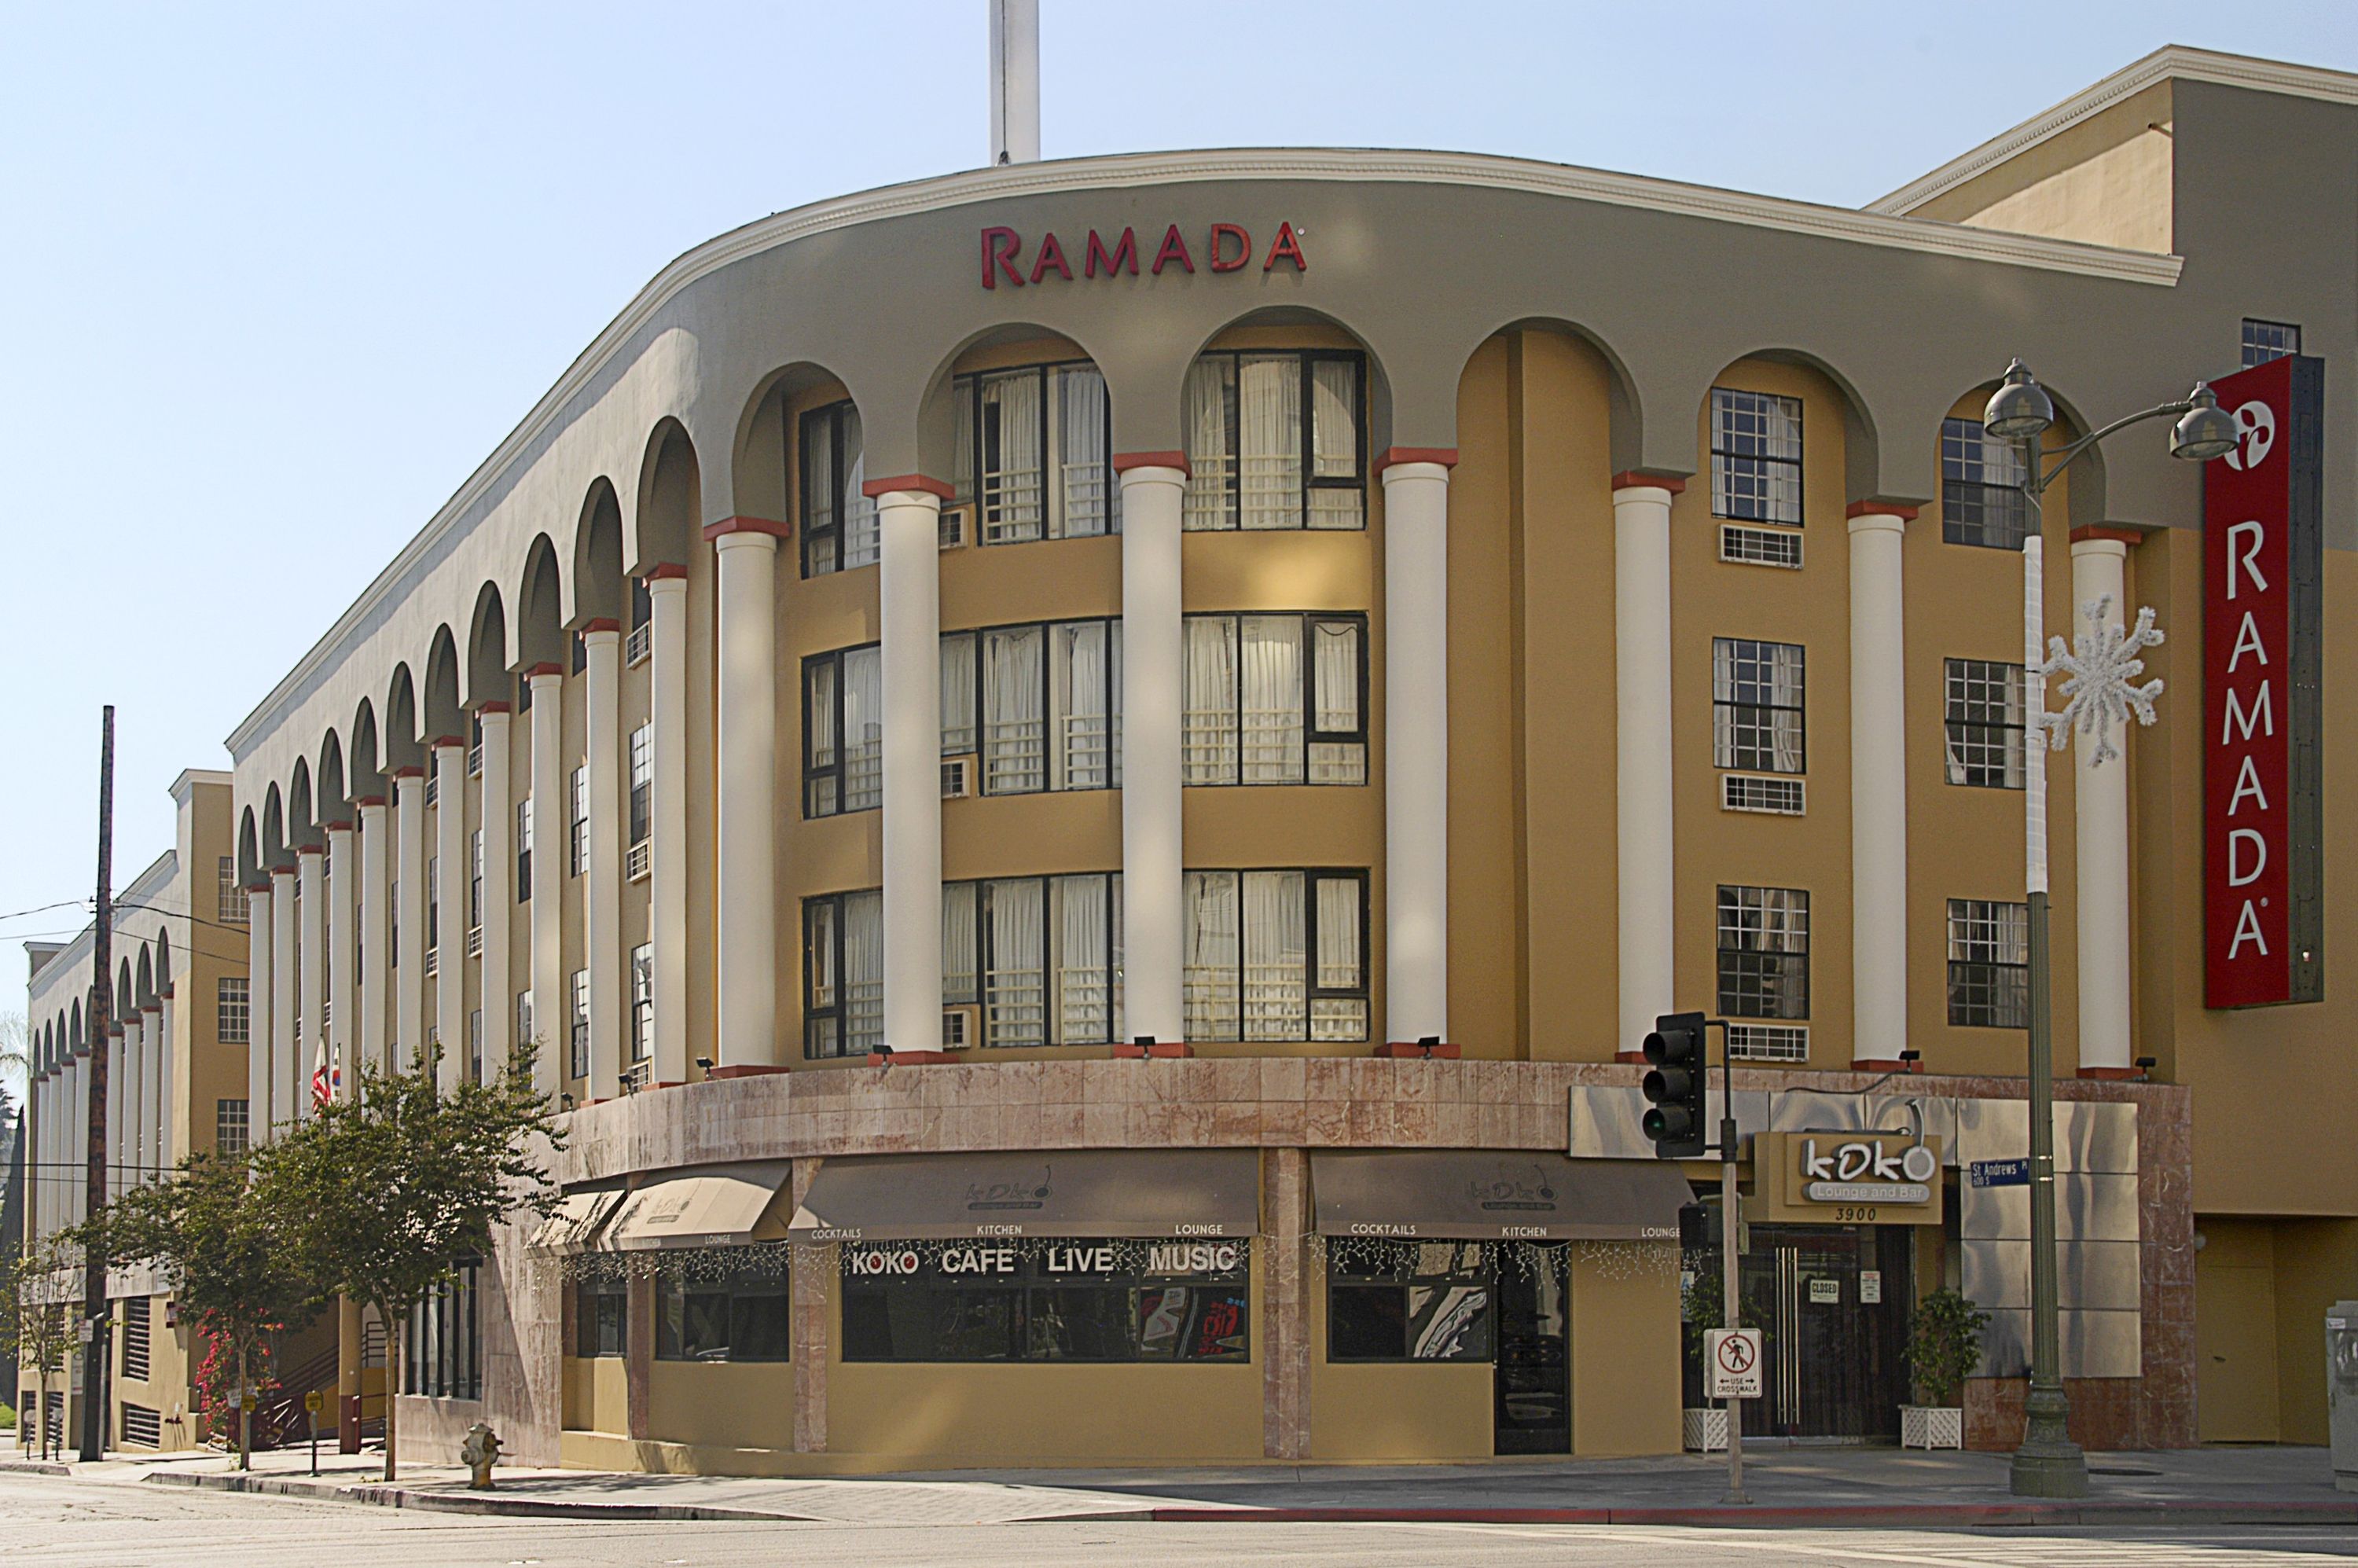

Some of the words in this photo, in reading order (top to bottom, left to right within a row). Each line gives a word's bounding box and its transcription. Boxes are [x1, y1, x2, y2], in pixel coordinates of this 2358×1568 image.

[981, 221, 1308, 289] RAMADA
[2222, 520, 2273, 960] RAMADA
[1973, 1164, 1981, 1177] St
[1984, 1163, 2017, 1176] Andrews
[1817, 1186, 1868, 1200] Lounge
[1871, 1186, 1896, 1197] and
[1900, 1187, 1923, 1198] Bar
[1835, 1208, 1876, 1221] 3900
[811, 1228, 861, 1239] COCKTAILS
[976, 1225, 1023, 1236] KITCHEN
[1175, 1224, 1223, 1235] LOUNGE
[1351, 1224, 1416, 1235] COCKTAILS
[1502, 1226, 1547, 1237] KITCHEN
[1641, 1227, 1680, 1238] LOUNGE
[705, 1234, 731, 1244] LOUNGE
[851, 1251, 920, 1274] KOKO
[942, 1249, 1015, 1273] CAFE
[1048, 1247, 1114, 1272] LIVE
[1149, 1245, 1236, 1271] MUSIC
[1812, 1282, 1837, 1294] CLOSED
